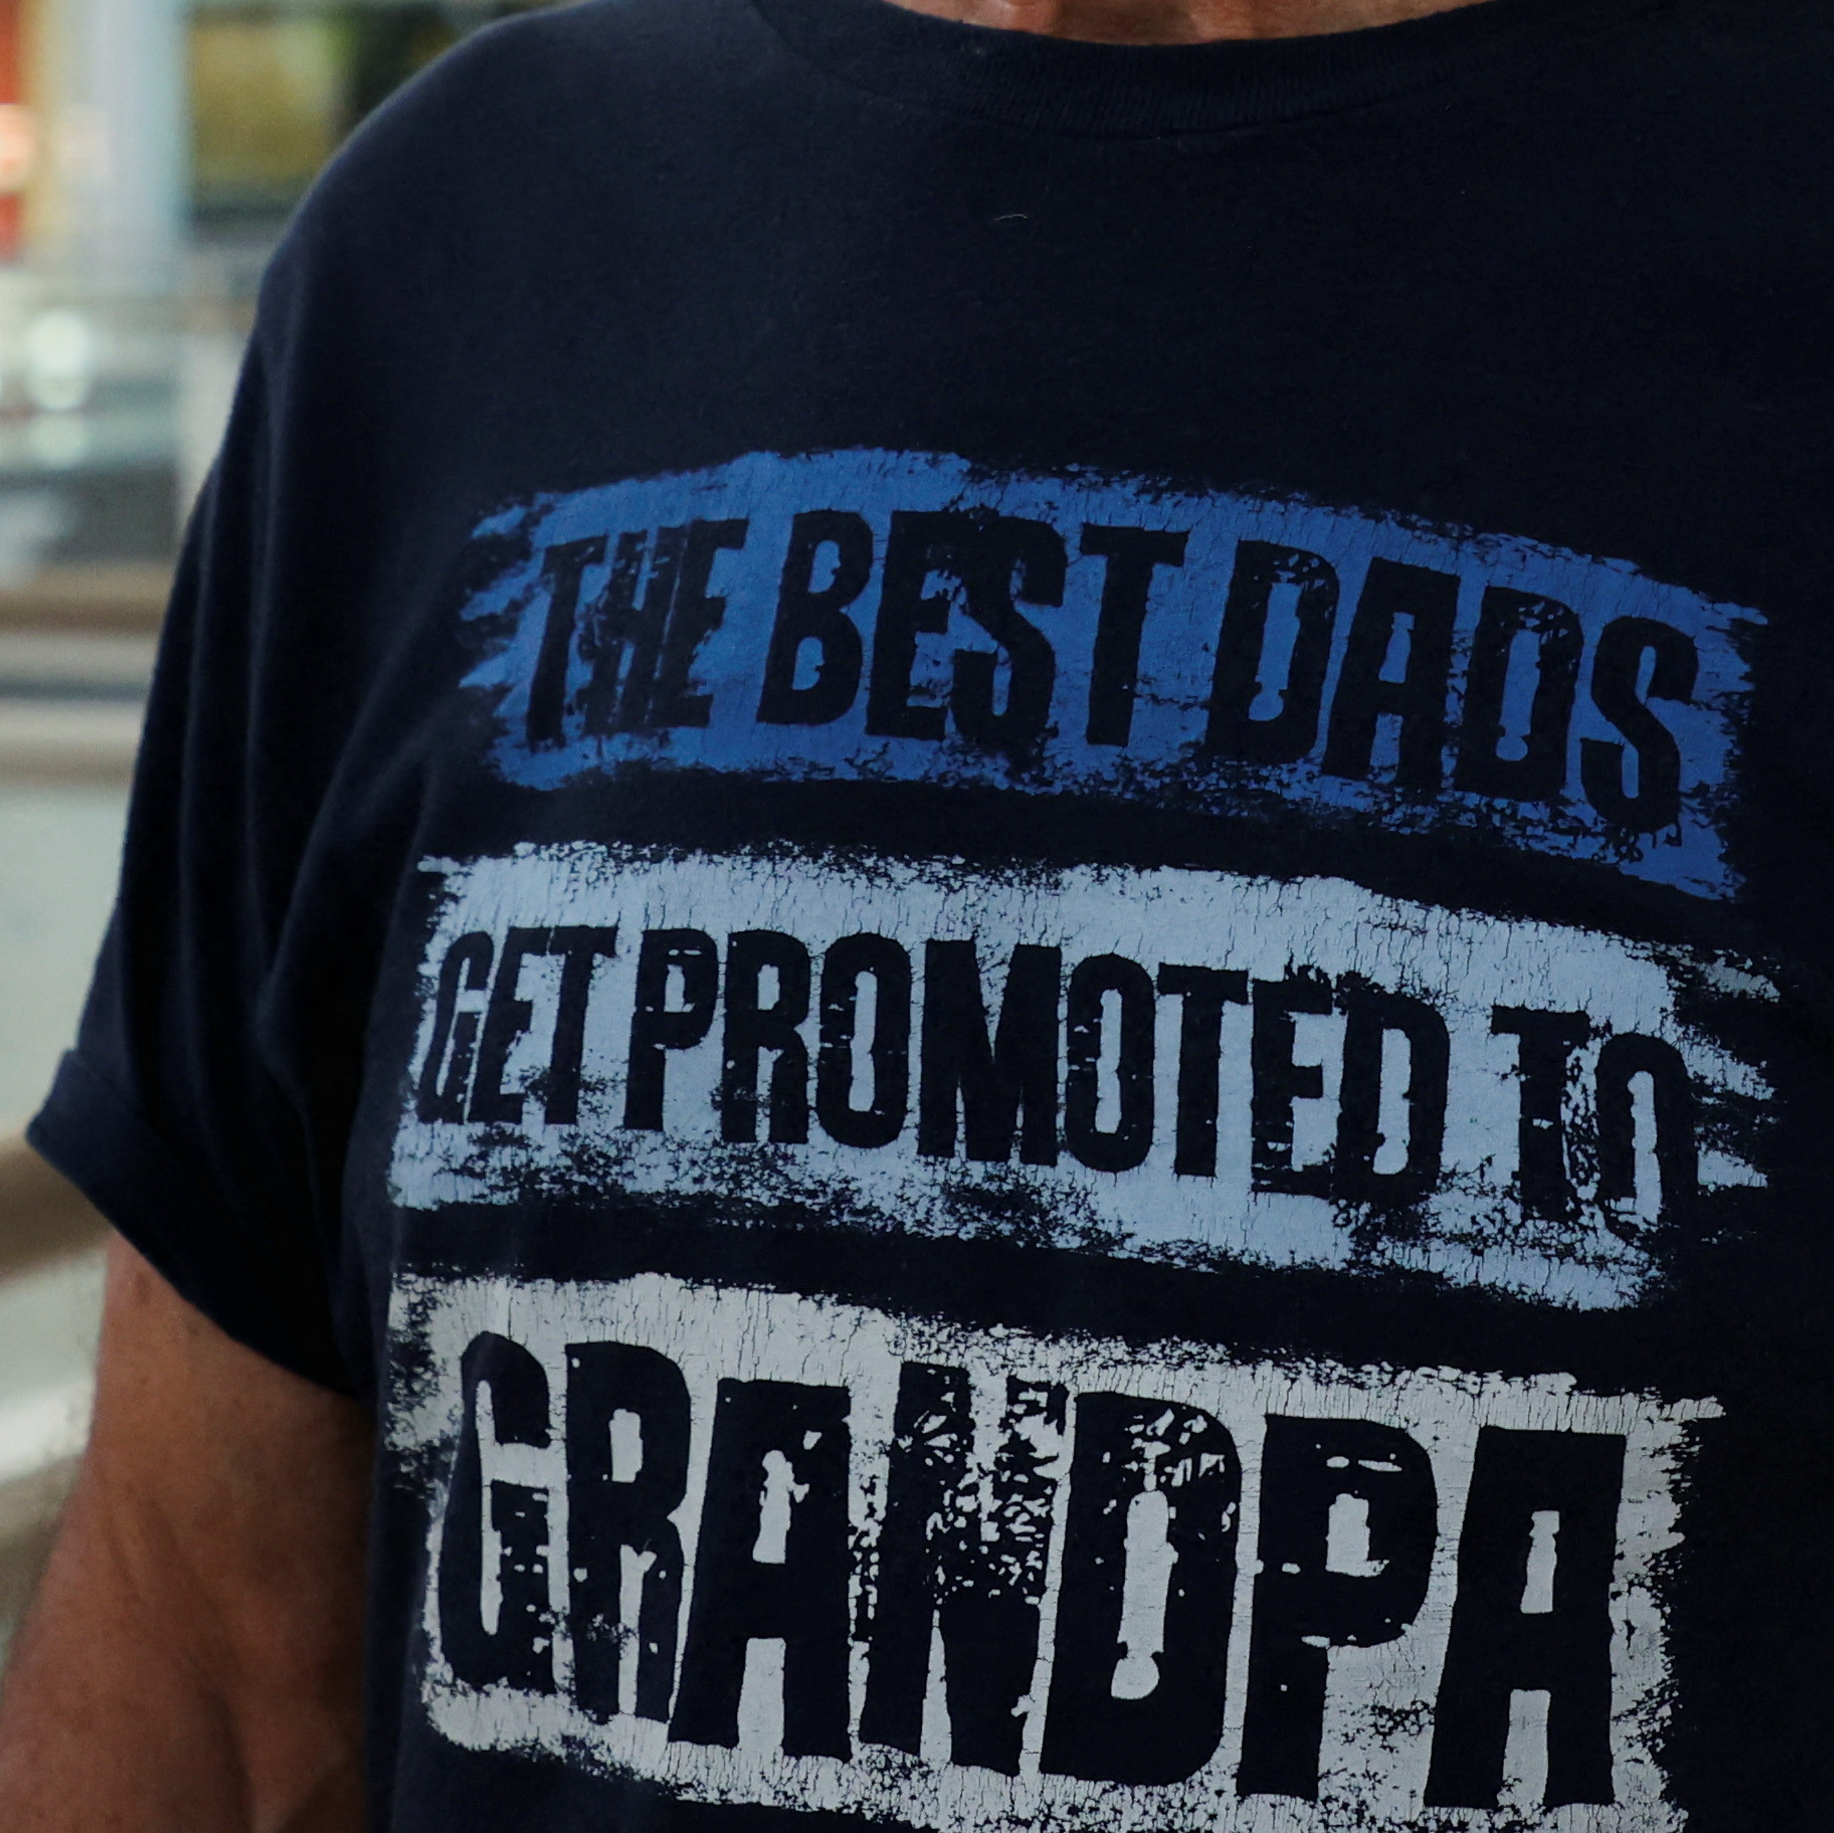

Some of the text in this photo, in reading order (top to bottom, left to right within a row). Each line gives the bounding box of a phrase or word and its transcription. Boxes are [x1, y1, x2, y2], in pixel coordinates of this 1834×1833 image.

[523, 510, 1699, 834] THE BEST DADS
[419, 924, 1697, 1238] GET PROMOTED TO
[435, 1330, 1629, 1812] GRANDPA
